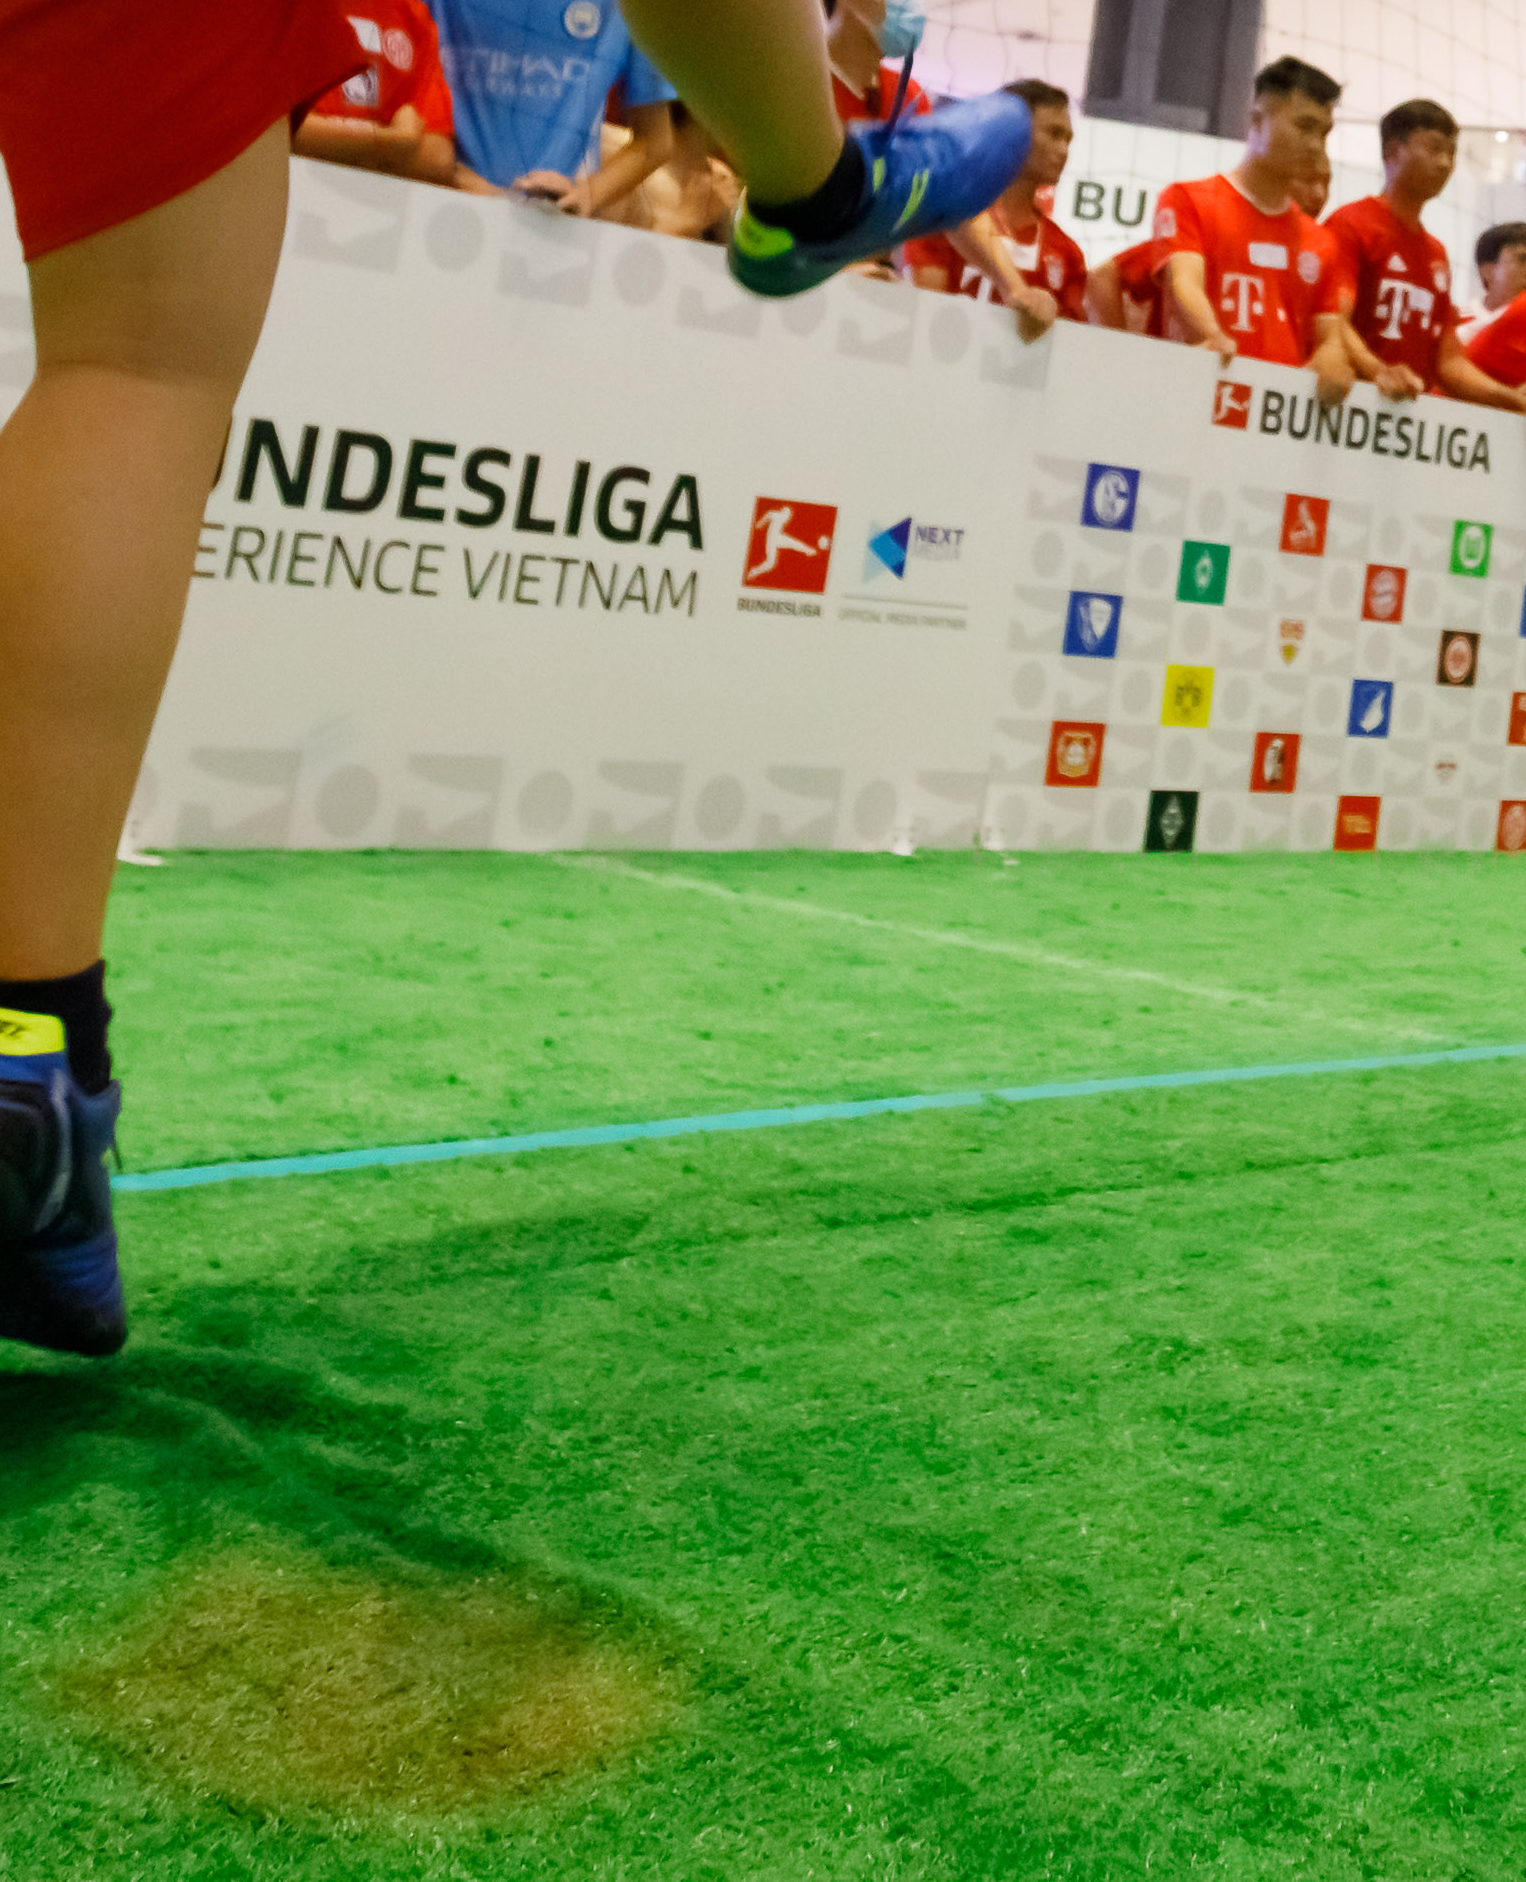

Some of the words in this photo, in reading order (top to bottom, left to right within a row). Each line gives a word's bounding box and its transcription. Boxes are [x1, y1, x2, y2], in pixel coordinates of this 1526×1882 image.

[1073, 181, 1147, 227] BU
[1260, 389, 1491, 474] BUNDESLIGA
[232, 417, 705, 552] NDESLIGA
[915, 525, 965, 545] NEXT
[193, 520, 447, 598] ERIENCE
[462, 547, 699, 619] VIETNAM
[736, 597, 822, 618] BUNDESLIGA
